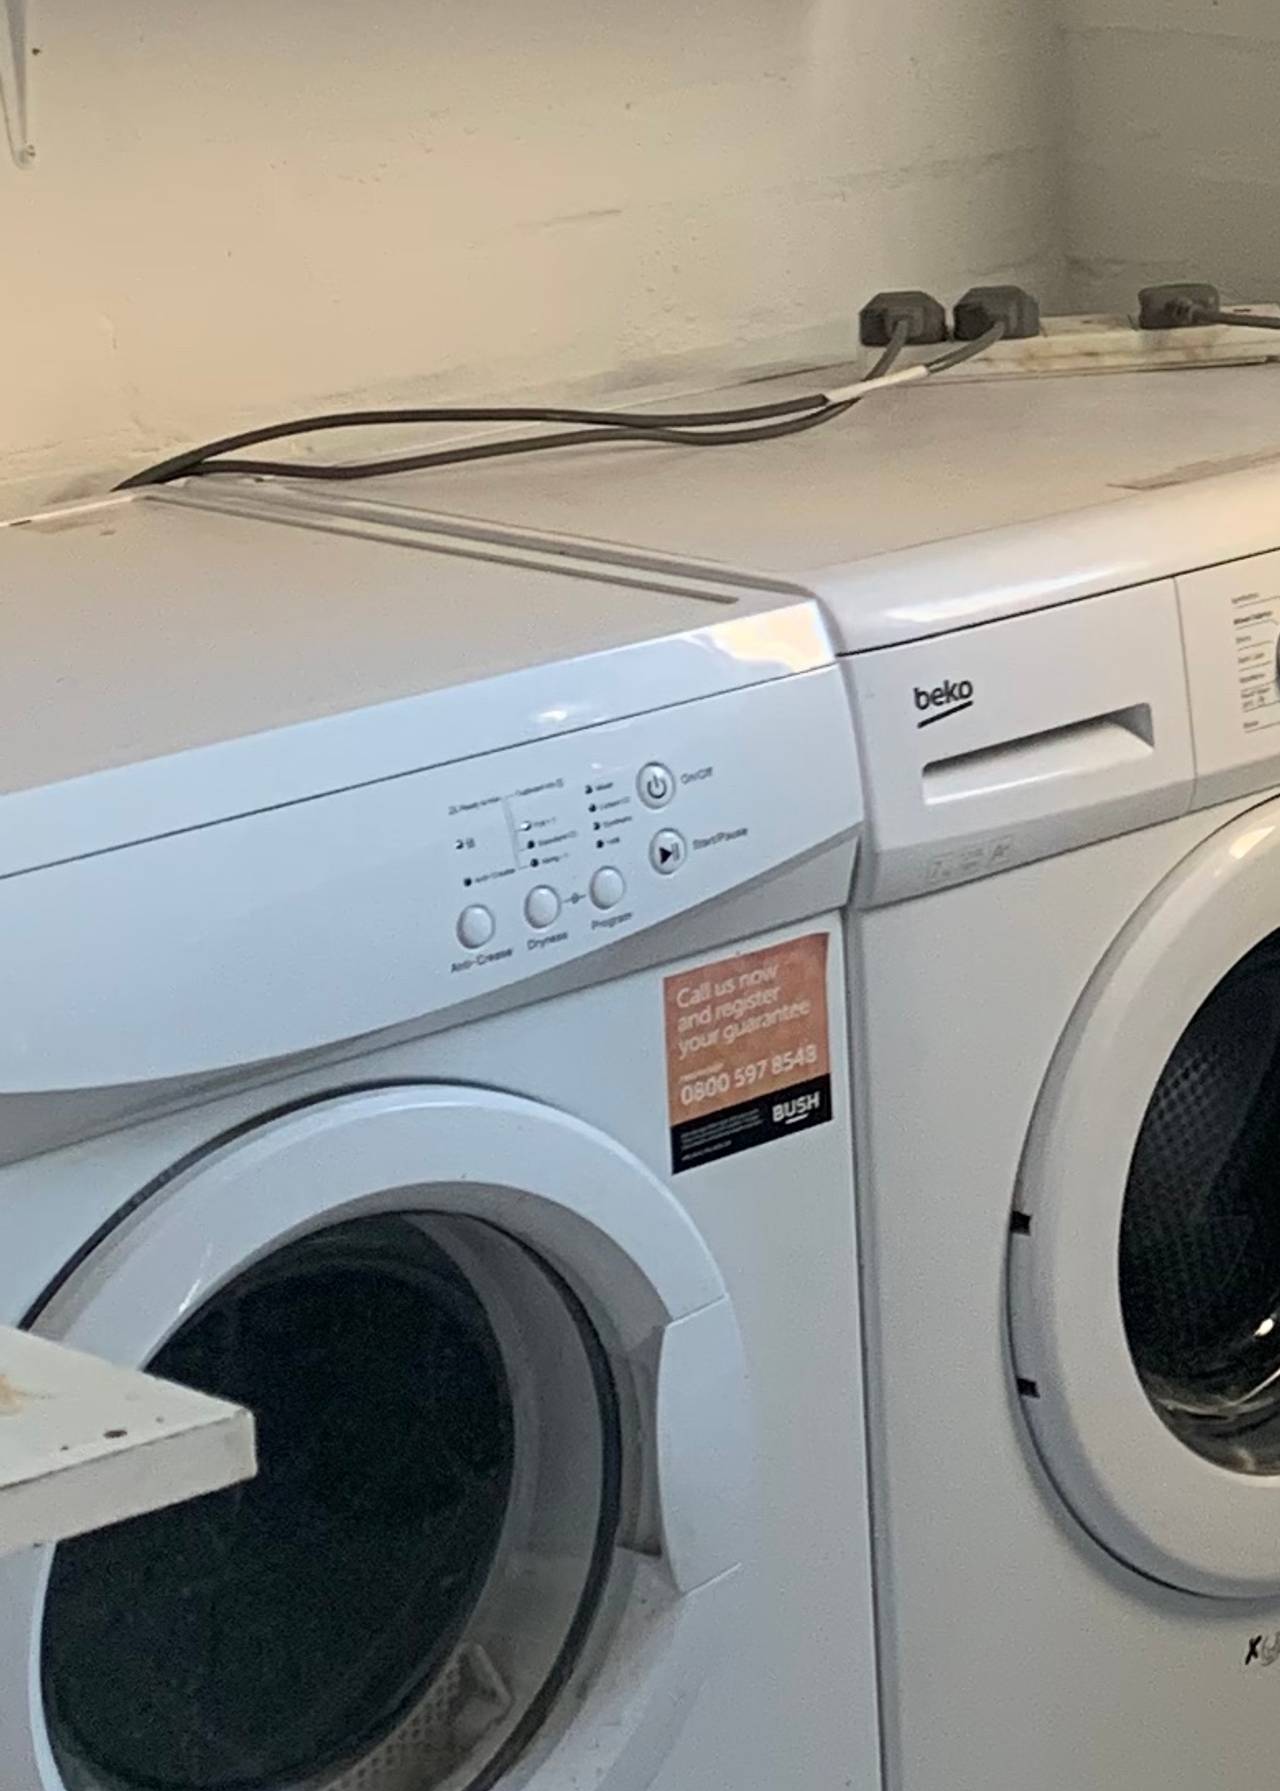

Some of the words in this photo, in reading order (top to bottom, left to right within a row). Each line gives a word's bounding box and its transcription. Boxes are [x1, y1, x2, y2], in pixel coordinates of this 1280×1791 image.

[913, 679, 974, 711] beko
[676, 982, 712, 1008] Call
[714, 977, 736, 996] us
[738, 964, 779, 990] now
[678, 1005, 712, 1033] and
[714, 985, 781, 1021] register
[678, 1028, 720, 1061] your
[722, 999, 811, 1045] guarantee
[681, 1073, 731, 1106] 0800
[771, 1090, 820, 1123] BUSH
